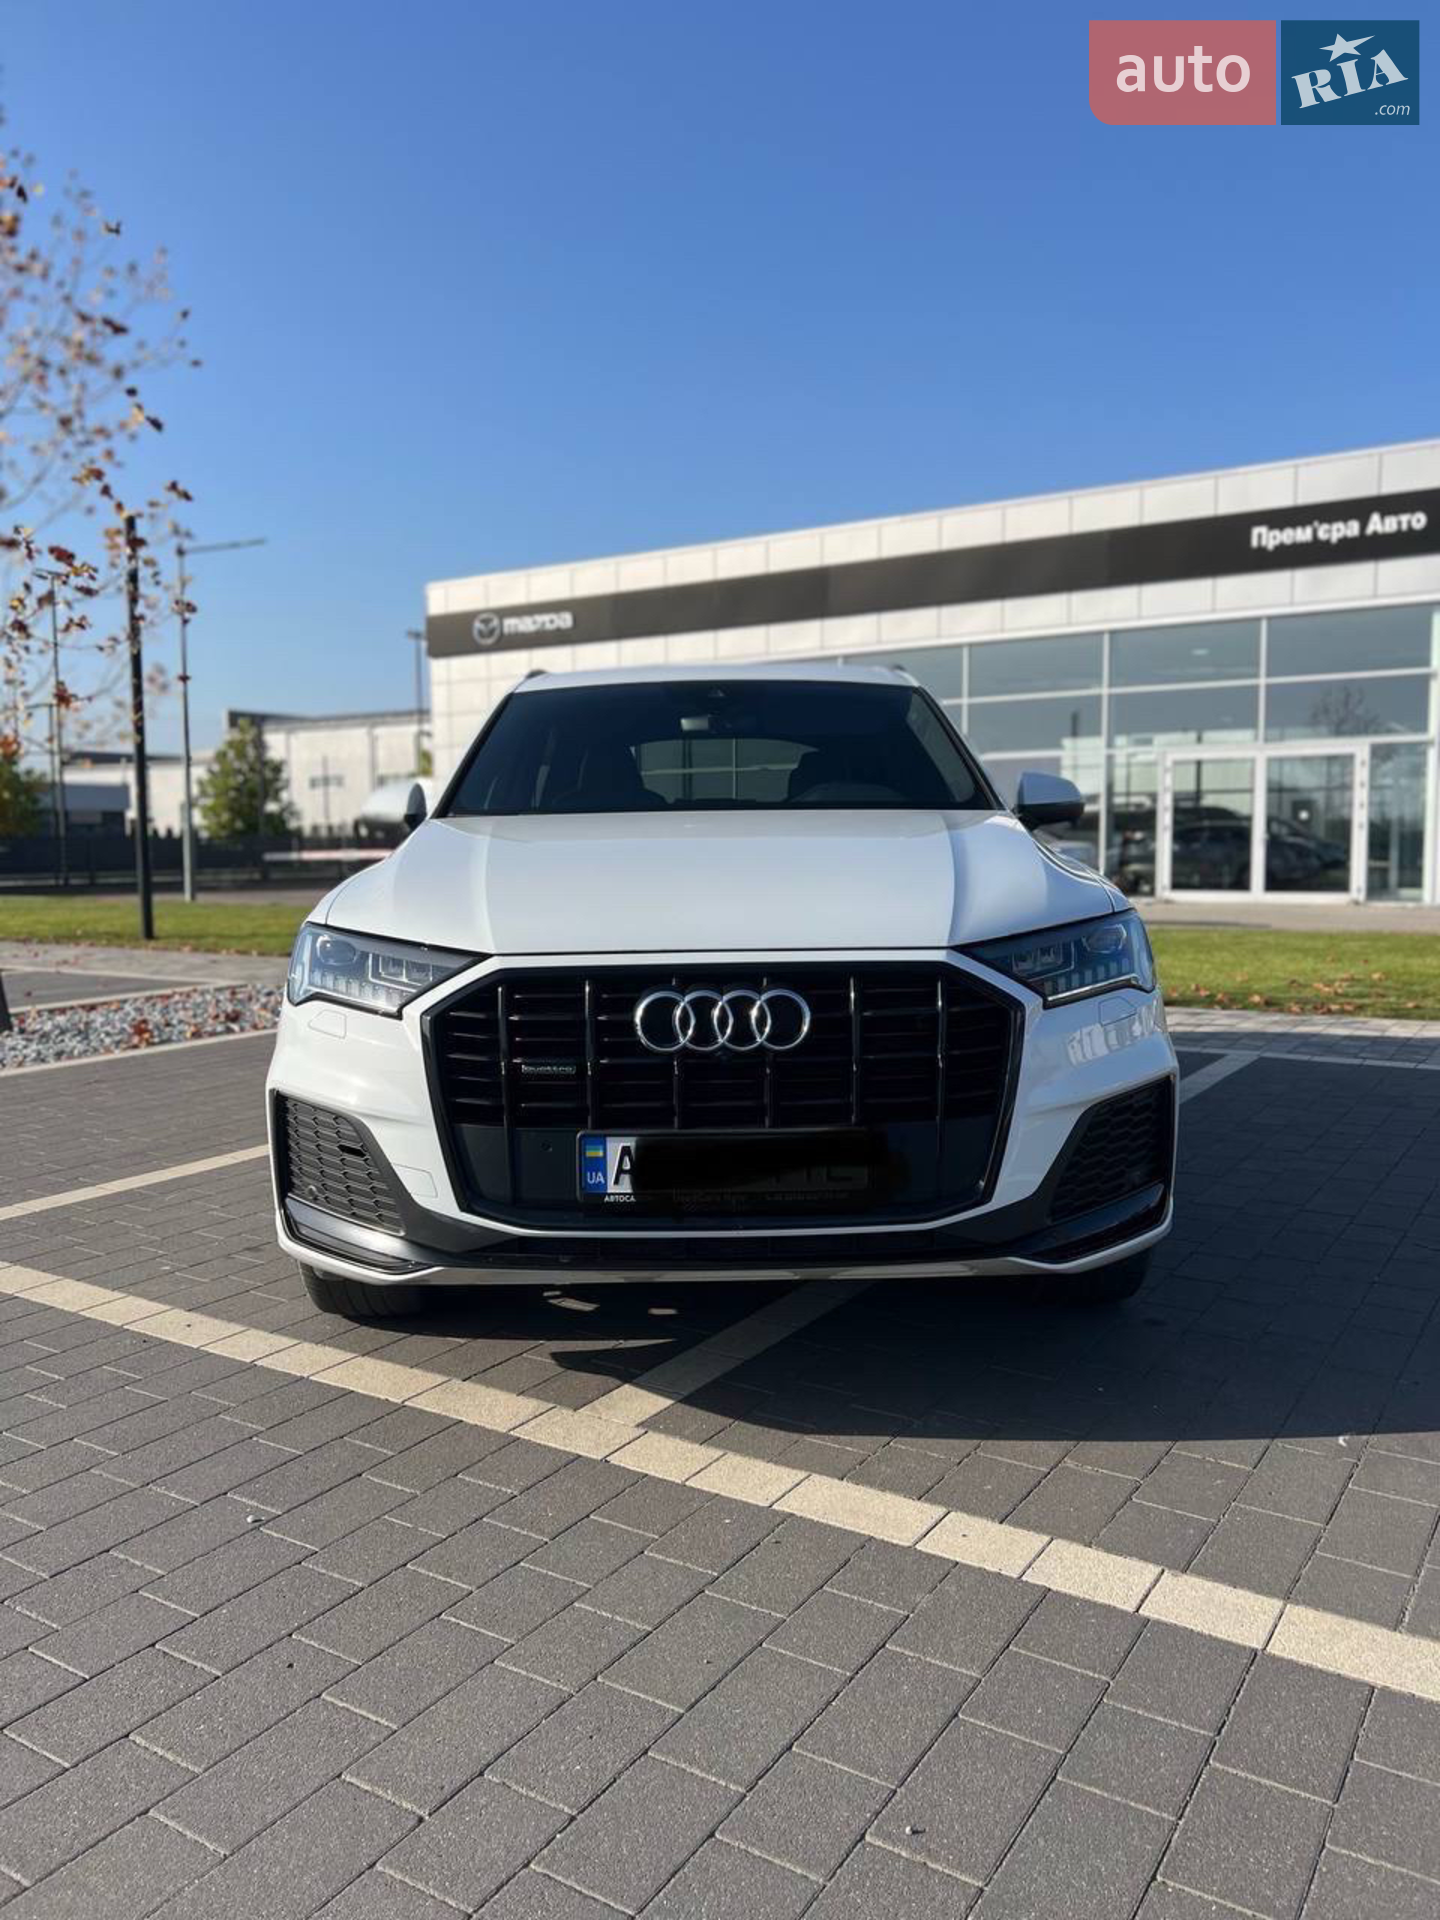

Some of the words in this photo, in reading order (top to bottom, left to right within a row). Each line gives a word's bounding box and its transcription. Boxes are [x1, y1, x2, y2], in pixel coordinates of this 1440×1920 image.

[1364, 510, 1428, 536] Авто
[586, 1171, 606, 1185] UA
[603, 1194, 637, 1203] АВТОСА
